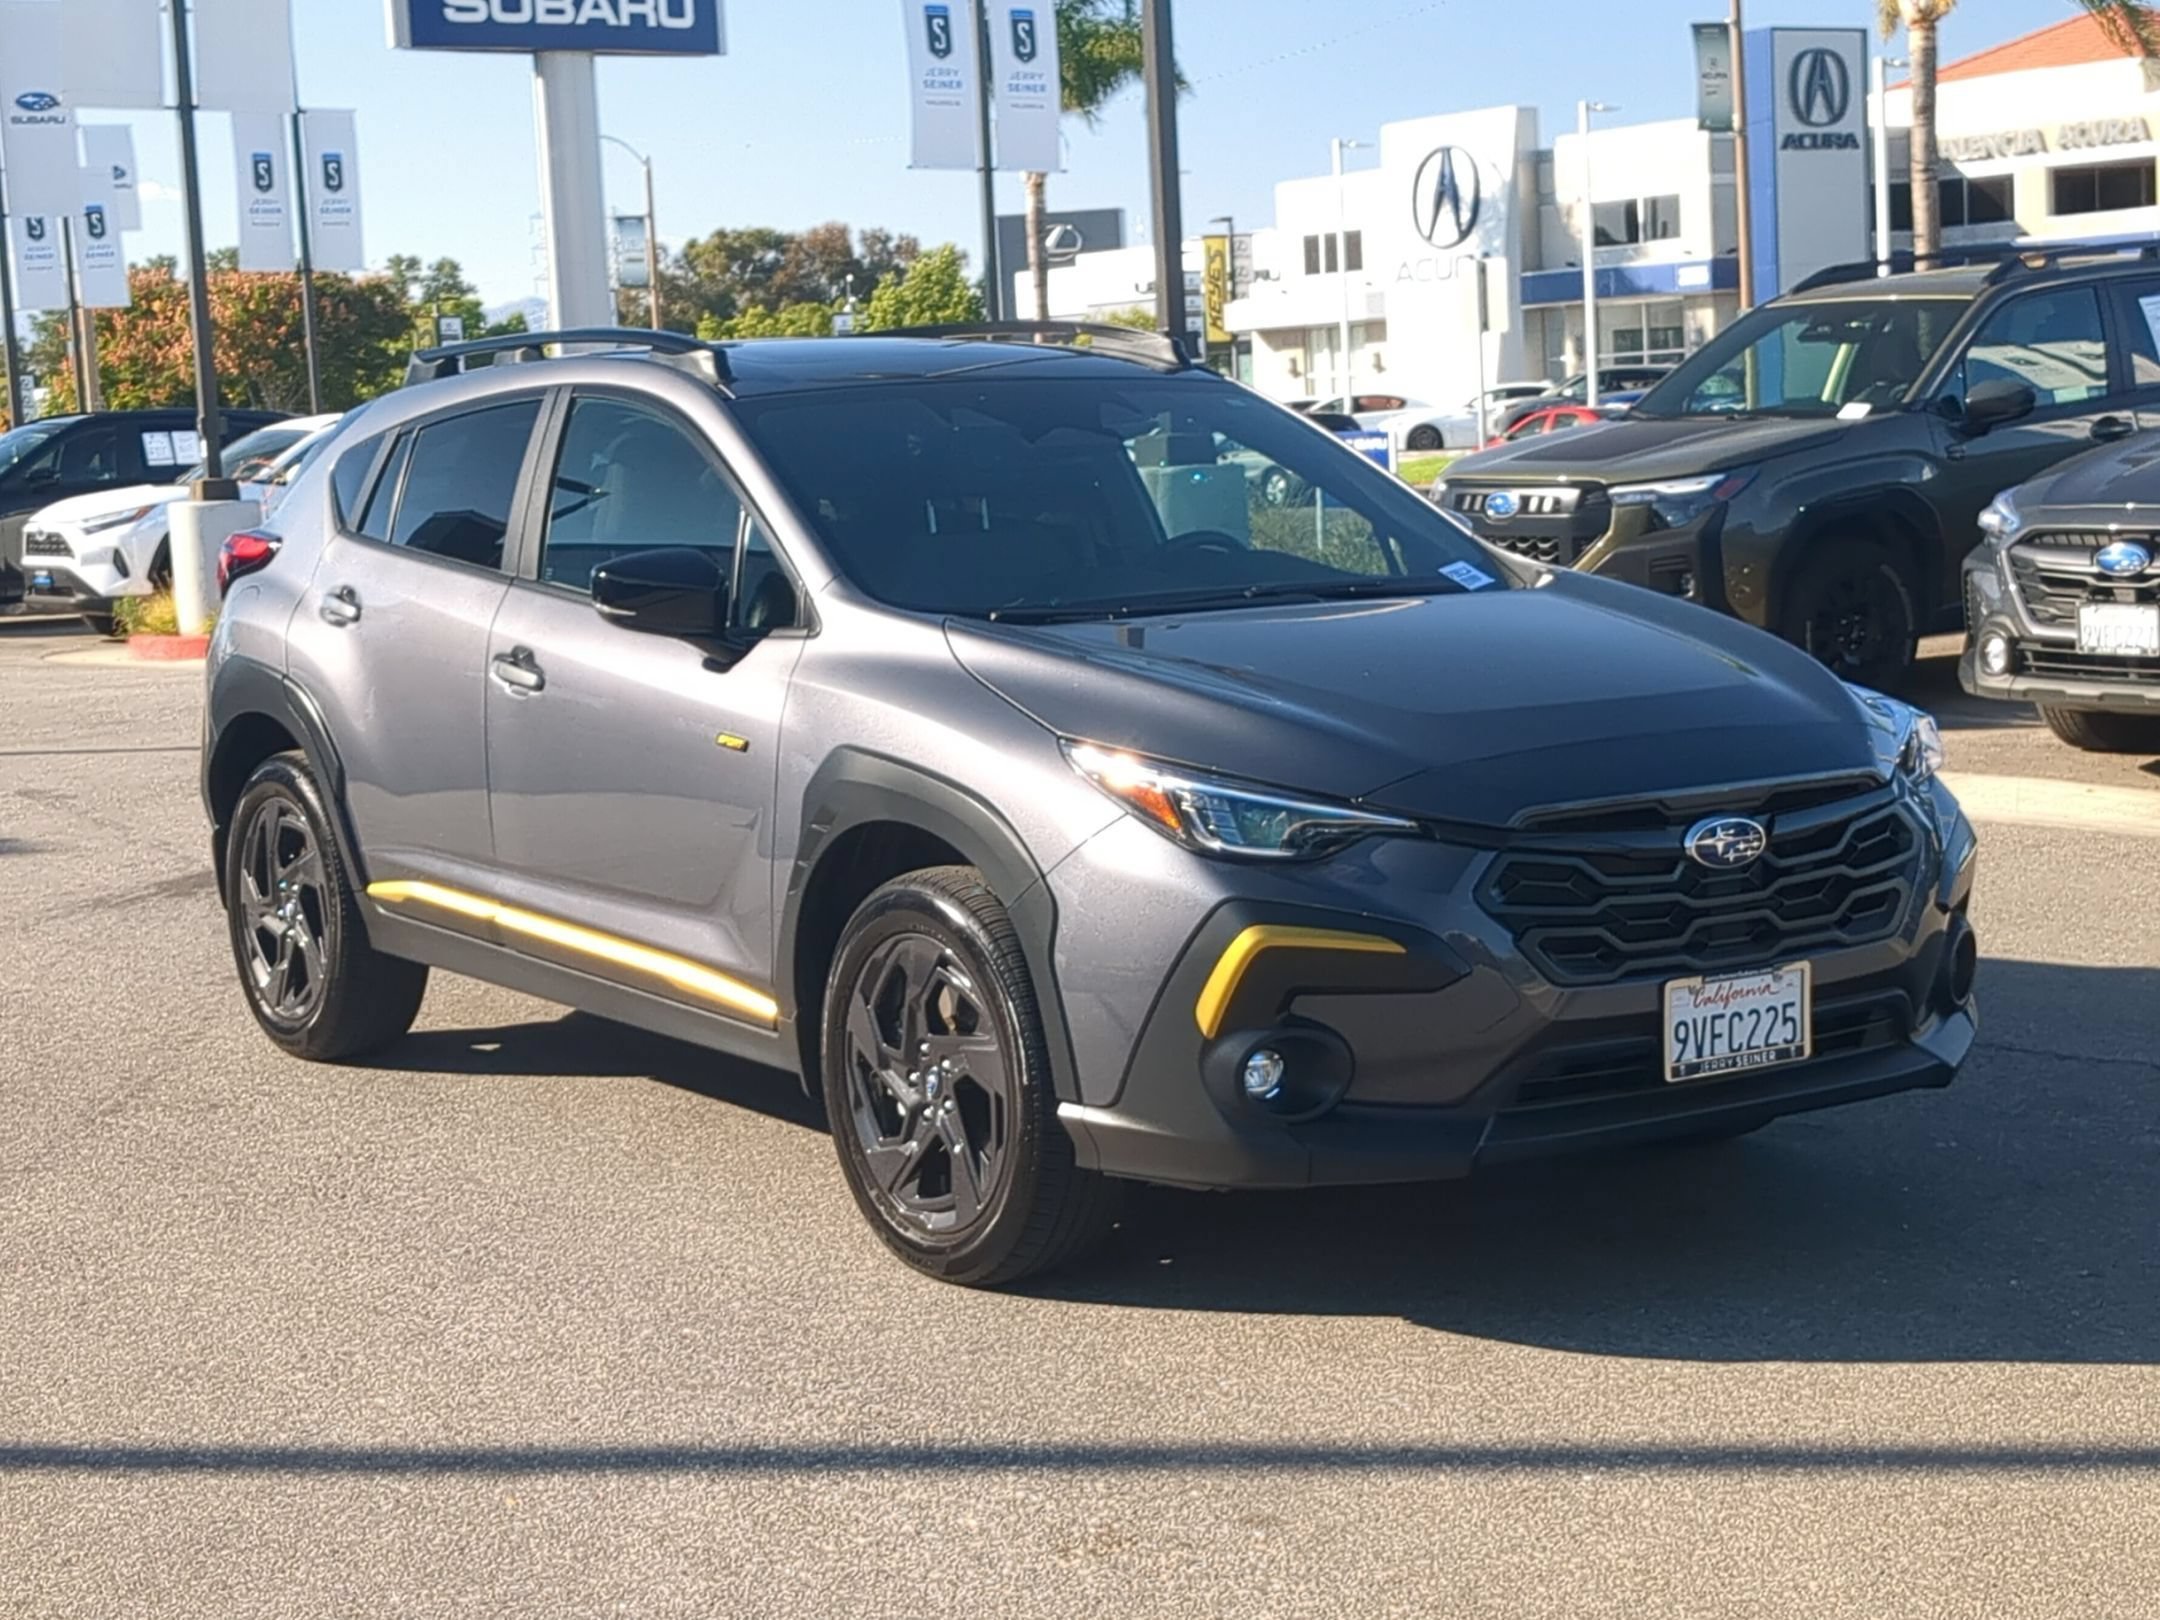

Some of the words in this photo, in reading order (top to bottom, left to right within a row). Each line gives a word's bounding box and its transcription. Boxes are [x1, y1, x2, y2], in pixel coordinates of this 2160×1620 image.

[443, 0, 694, 29] SUBARU
[925, 67, 960, 77] JERRY
[1010, 71, 1045, 81] JERRY
[922, 79, 962, 89] SEINER
[1007, 83, 1046, 93] SEINER
[10, 115, 66, 125] SUBARU
[1779, 131, 1861, 151] ACURA
[1937, 129, 2048, 162] ALENCIA
[1693, 979, 1779, 1009] California
[1674, 1001, 1797, 1063] 9VFC225
[1700, 1057, 1733, 1073] JERRY
[1735, 1050, 1777, 1067] SEINER
